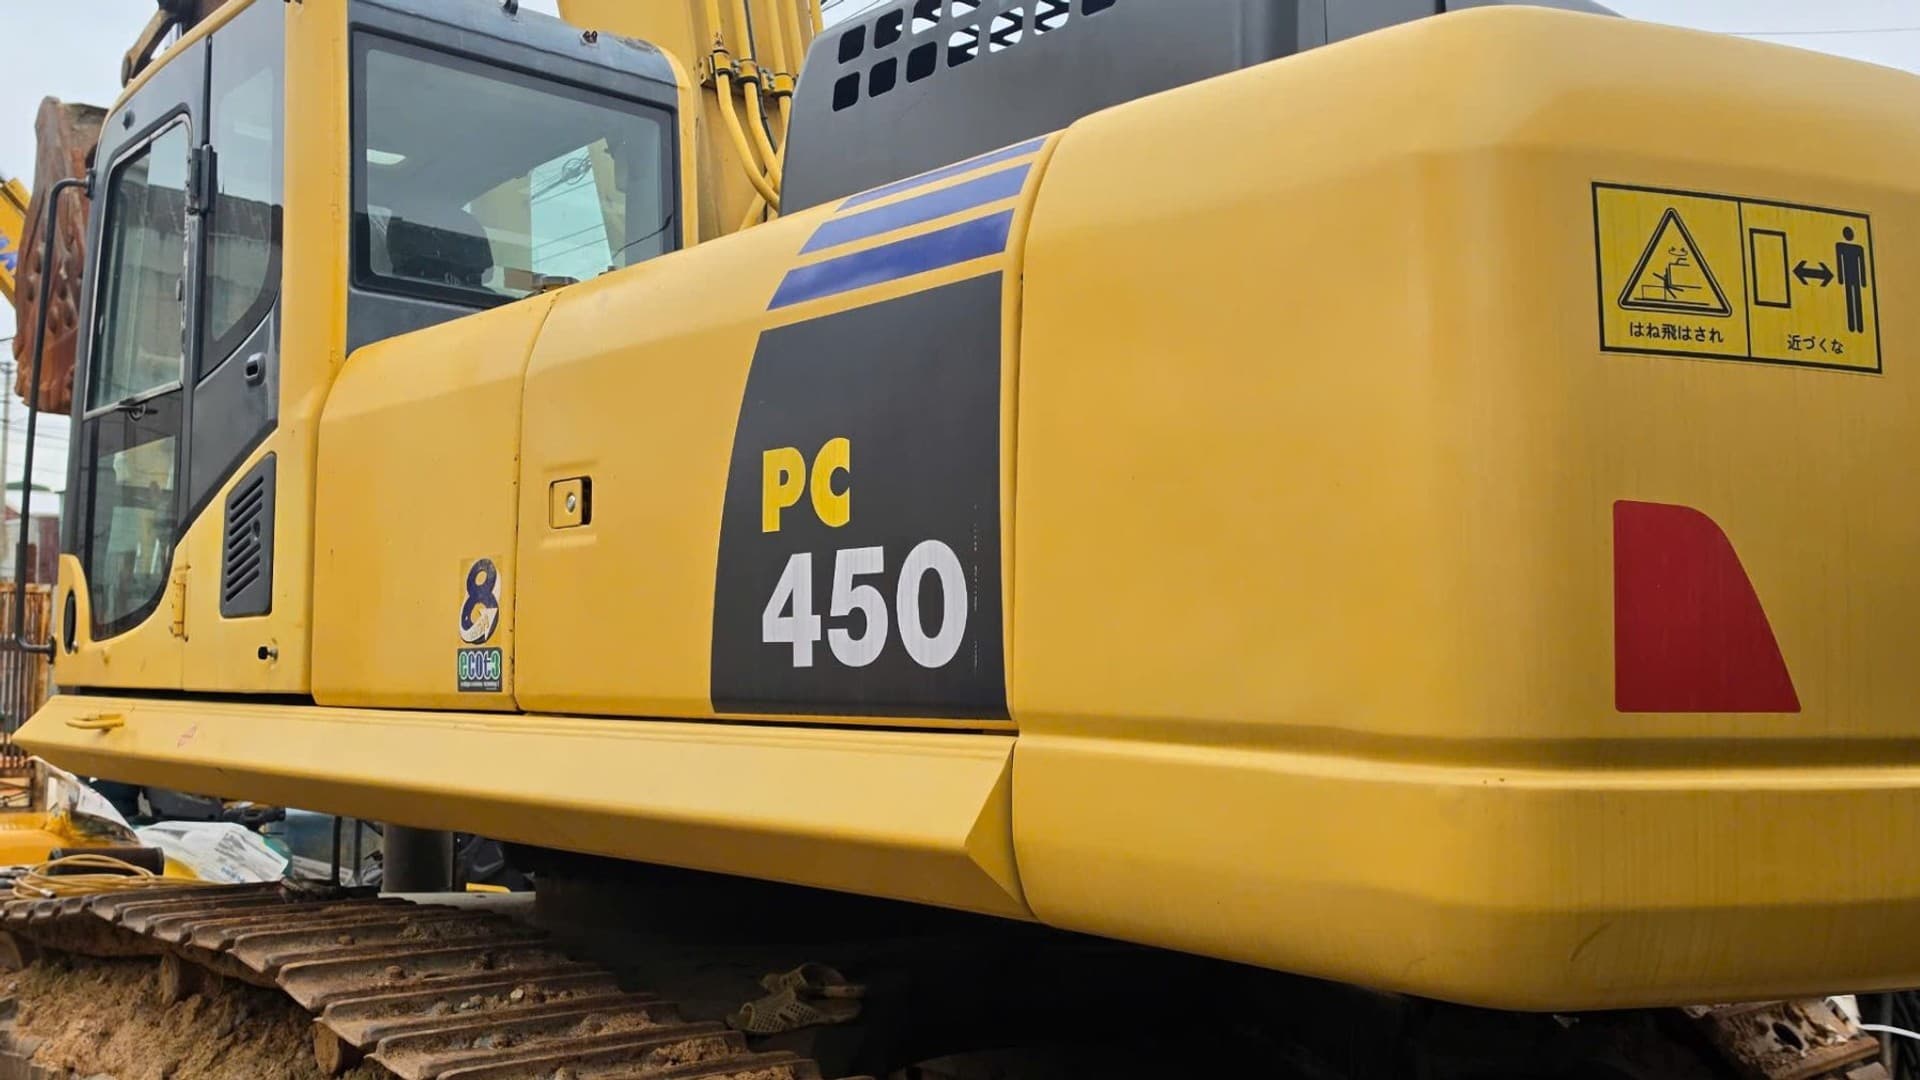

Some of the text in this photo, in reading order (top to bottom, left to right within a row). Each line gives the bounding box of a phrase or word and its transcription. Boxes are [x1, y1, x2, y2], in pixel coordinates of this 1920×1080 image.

[1787, 334, 1844, 354] 近づくな
[762, 437, 850, 533] PC
[460, 558, 501, 645] 8
[762, 539, 968, 669] 450
[459, 650, 501, 680] ecot3
